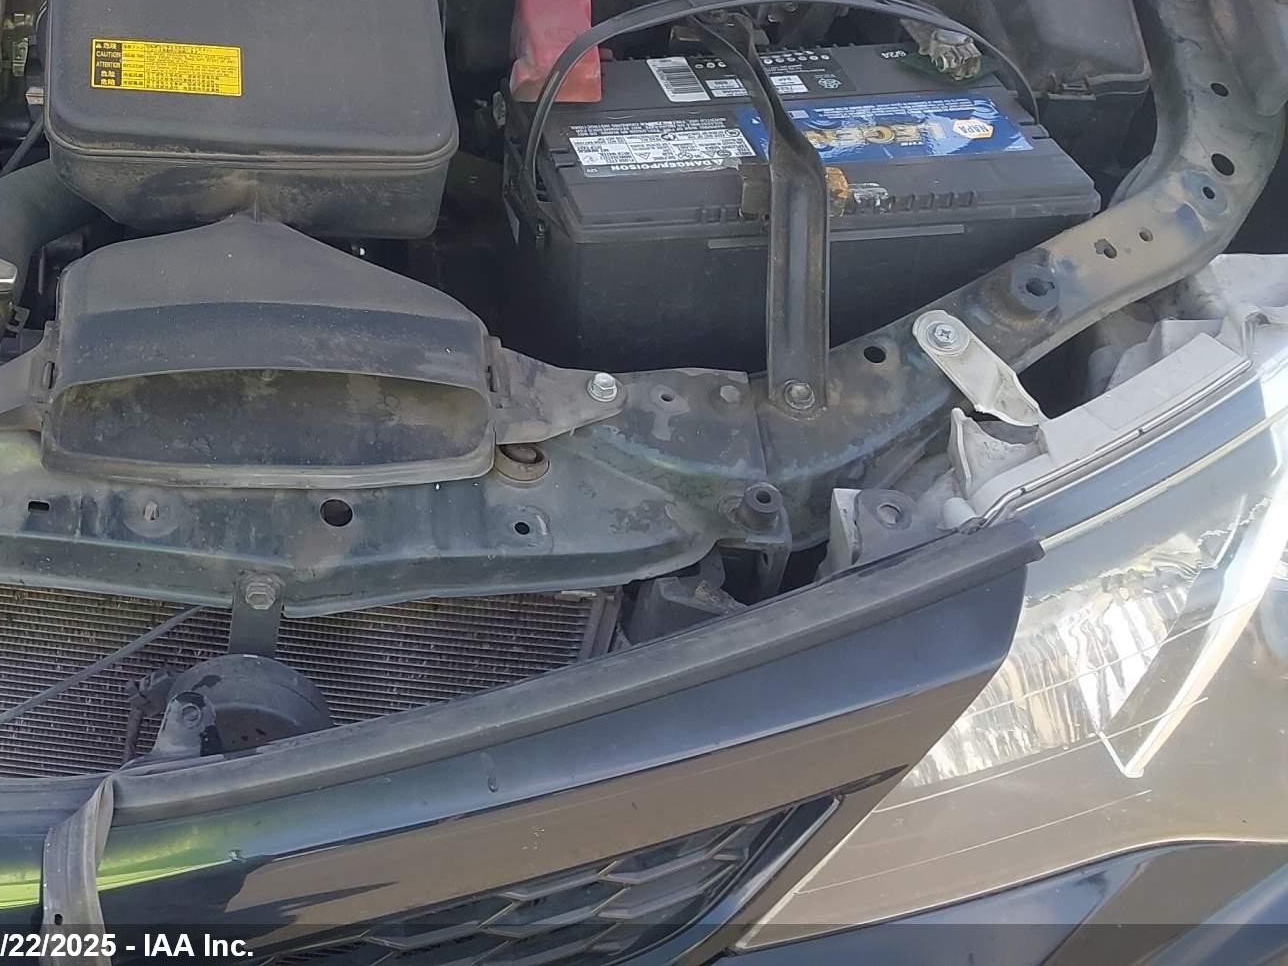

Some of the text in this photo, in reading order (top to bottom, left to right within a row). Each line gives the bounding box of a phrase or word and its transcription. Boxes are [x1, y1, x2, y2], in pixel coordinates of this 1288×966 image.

[95, 50, 122, 59] CAUTION
[95, 61, 121, 69] ATTENTION
[803, 121, 947, 148] LEGEN
[958, 124, 989, 135] NAPA
[610, 159, 713, 171] DANGER/POISON
